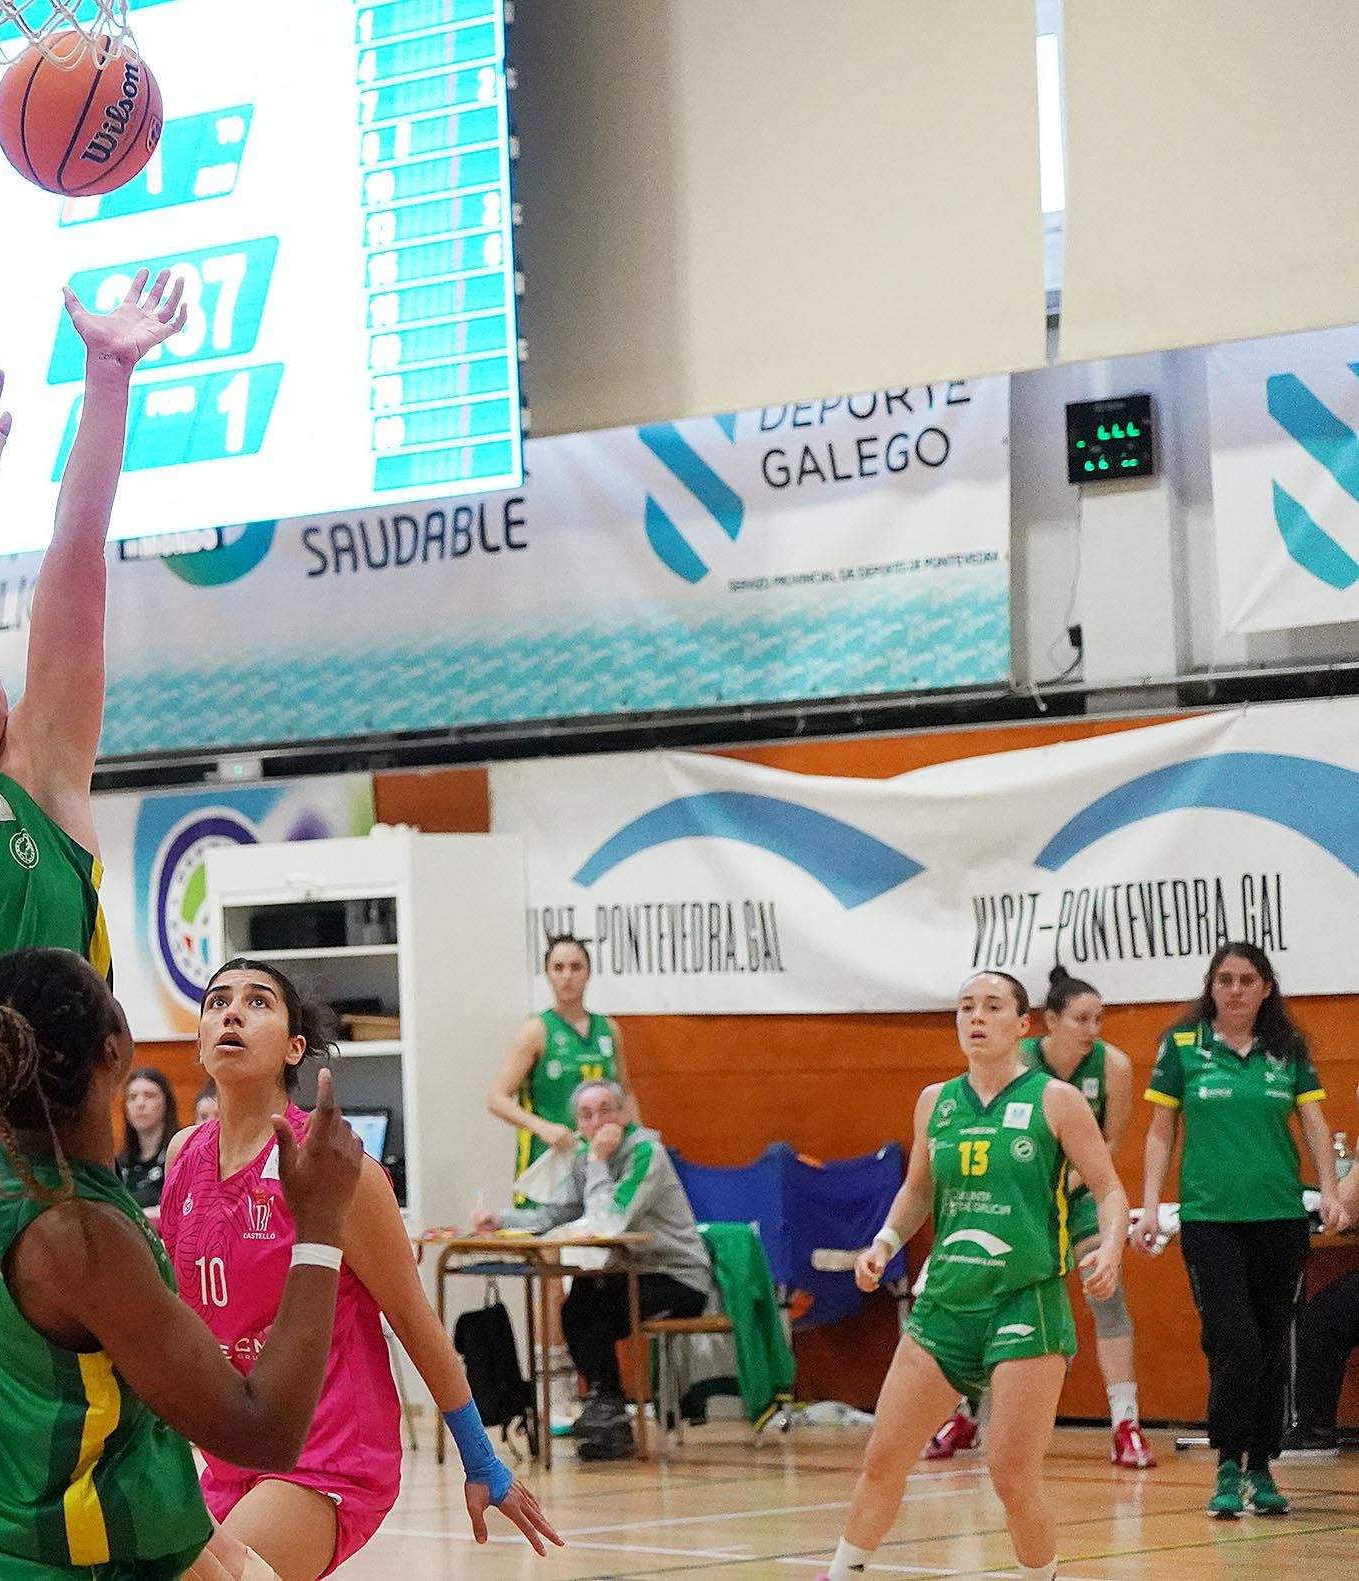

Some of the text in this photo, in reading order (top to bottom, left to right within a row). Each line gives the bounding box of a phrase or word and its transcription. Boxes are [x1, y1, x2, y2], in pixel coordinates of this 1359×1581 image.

[80, 62, 139, 164] Wilson
[216, 371, 250, 452] 1
[762, 427, 950, 488] GALEGO
[301, 497, 528, 578] SAUDABLE
[972, 873, 1288, 967] VISIT-PONTEVEDRAGAL
[958, 1140, 991, 1176] 13
[195, 1255, 229, 1308] 10
